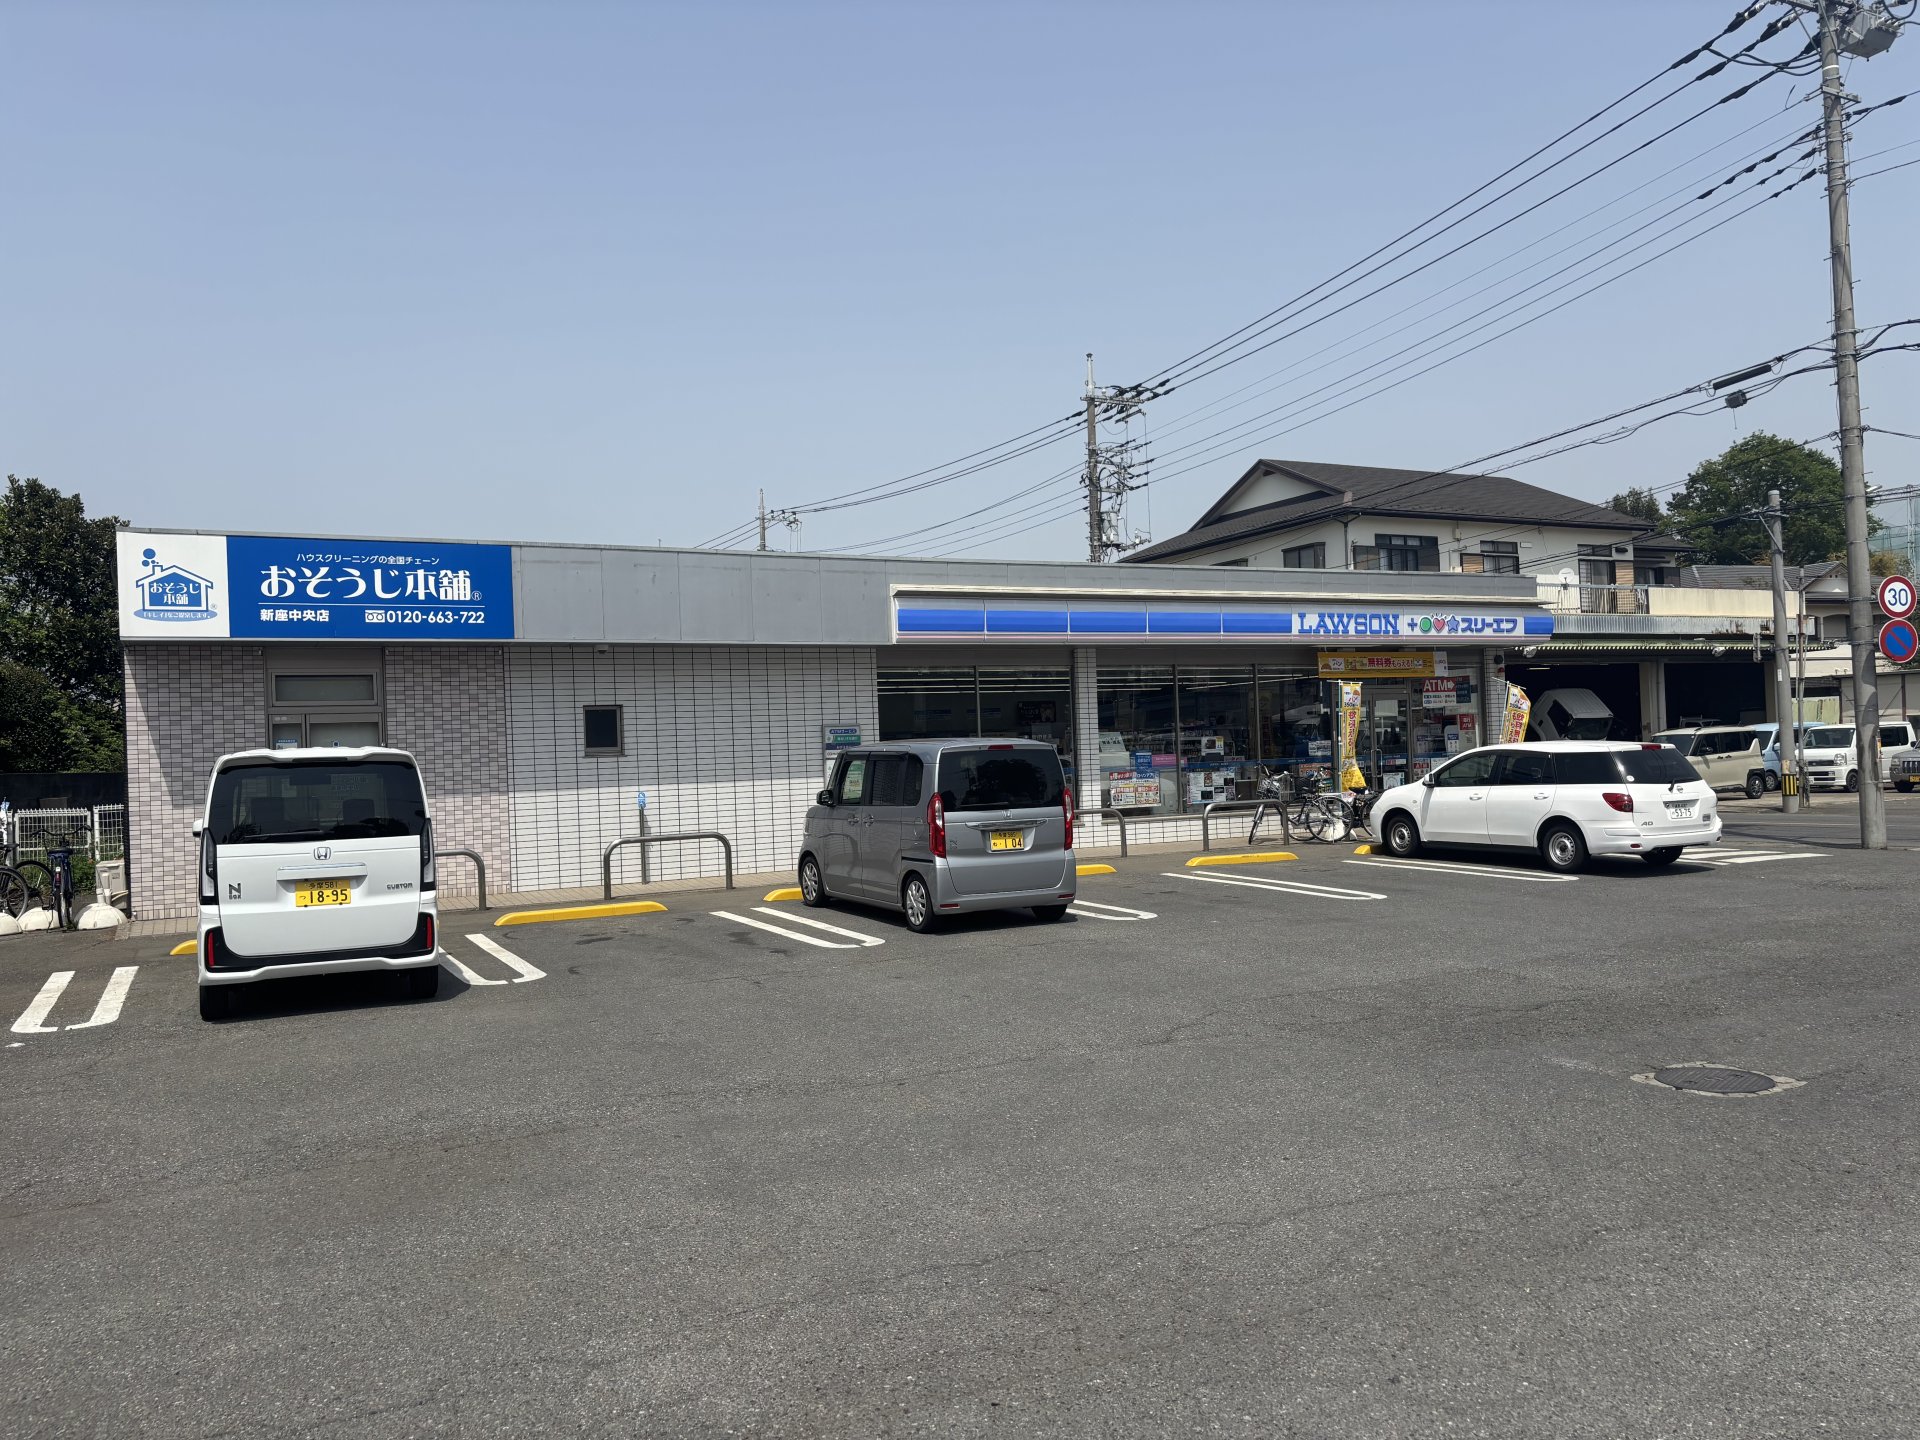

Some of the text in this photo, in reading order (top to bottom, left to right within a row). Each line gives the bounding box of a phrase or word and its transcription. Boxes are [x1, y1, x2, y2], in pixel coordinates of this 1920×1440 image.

[296, 553, 440, 565] ハウスクリーニングの全国チェーン
[150, 582, 200, 594] おそうじ
[163, 593, 189, 605] 本舗
[1887, 588, 1908, 606] 30
[260, 608, 330, 622] 新座中央店
[386, 610, 485, 624] 0120-663-722
[1297, 612, 1400, 635] LAWSON
[1461, 617, 1518, 633] スリーエフ
[1423, 679, 1448, 692] ATM
[324, 881, 338, 889] 581
[386, 882, 413, 890] CUSTOM
[310, 888, 348, 904] 18-95
